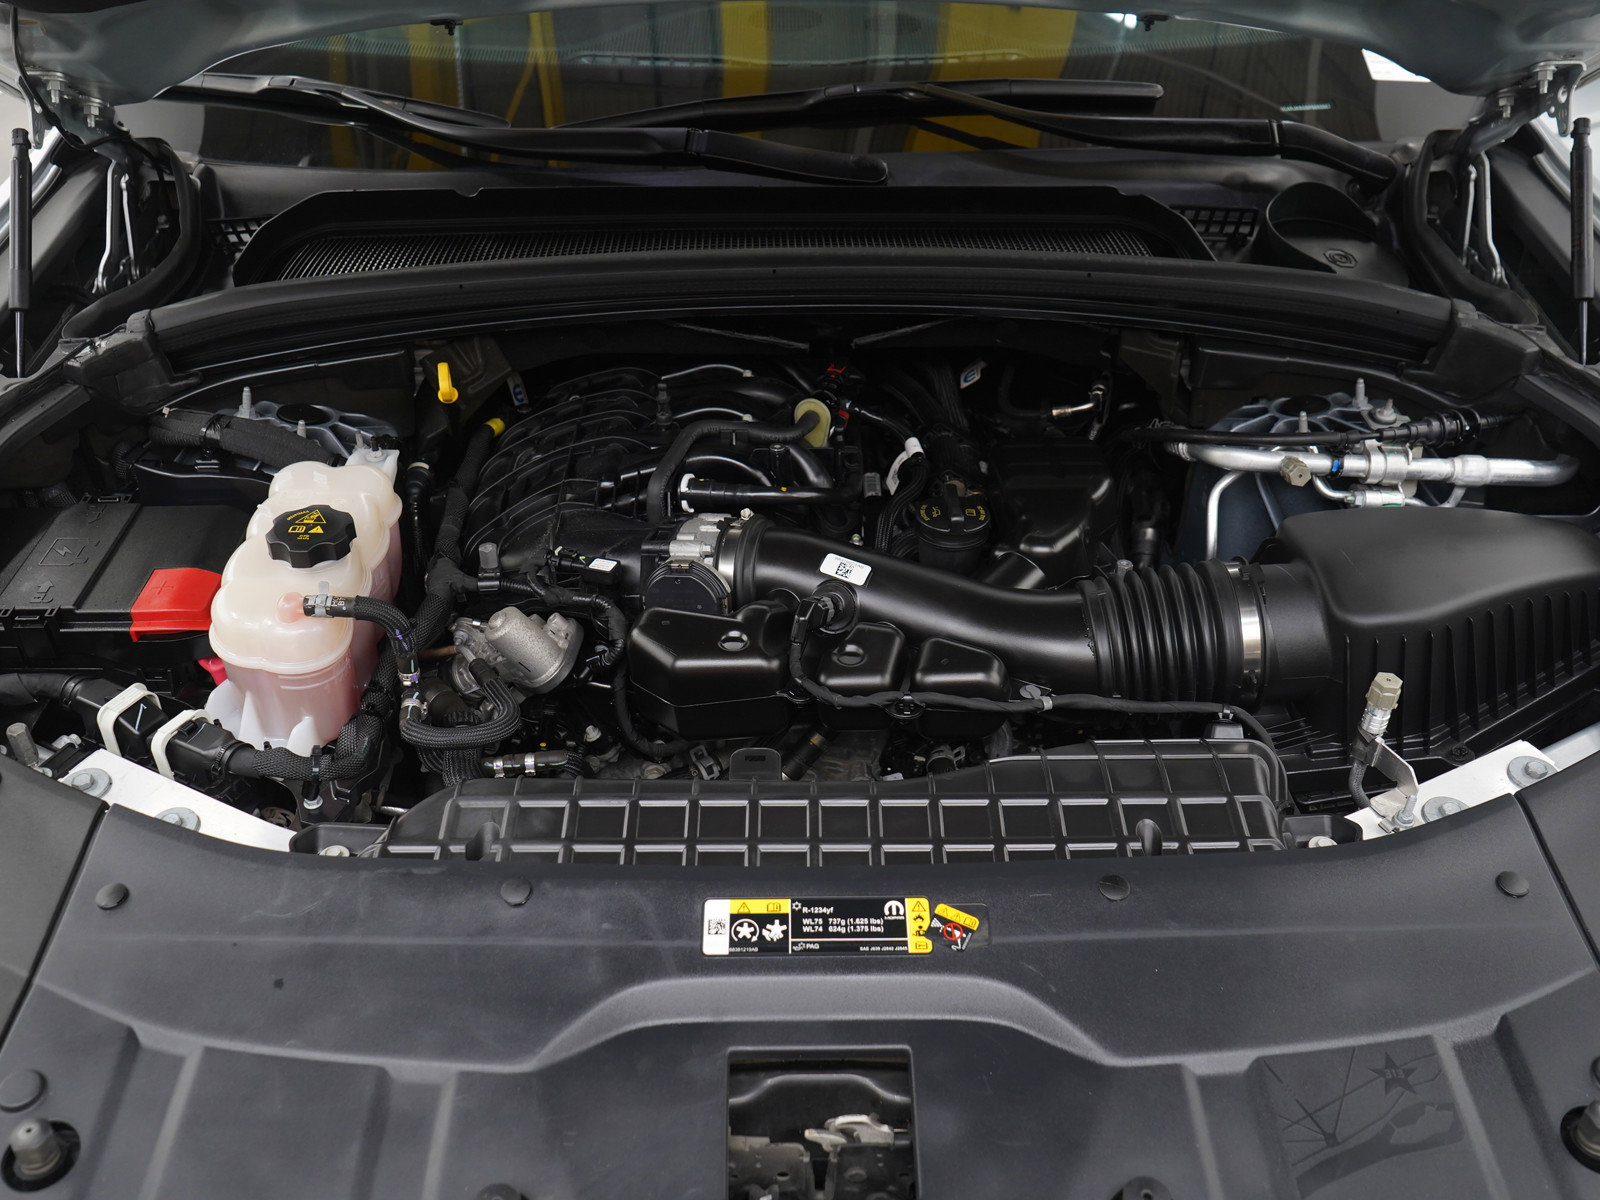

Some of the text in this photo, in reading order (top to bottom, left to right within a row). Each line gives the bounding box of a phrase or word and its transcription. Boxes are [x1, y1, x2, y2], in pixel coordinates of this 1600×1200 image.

[802, 907, 834, 915] R-1234yf
[828, 918, 846, 926] 737g
[847, 918, 868, 926] (1.625
[870, 918, 884, 926] lbs)
[1384, 1068, 1405, 1079] 313
